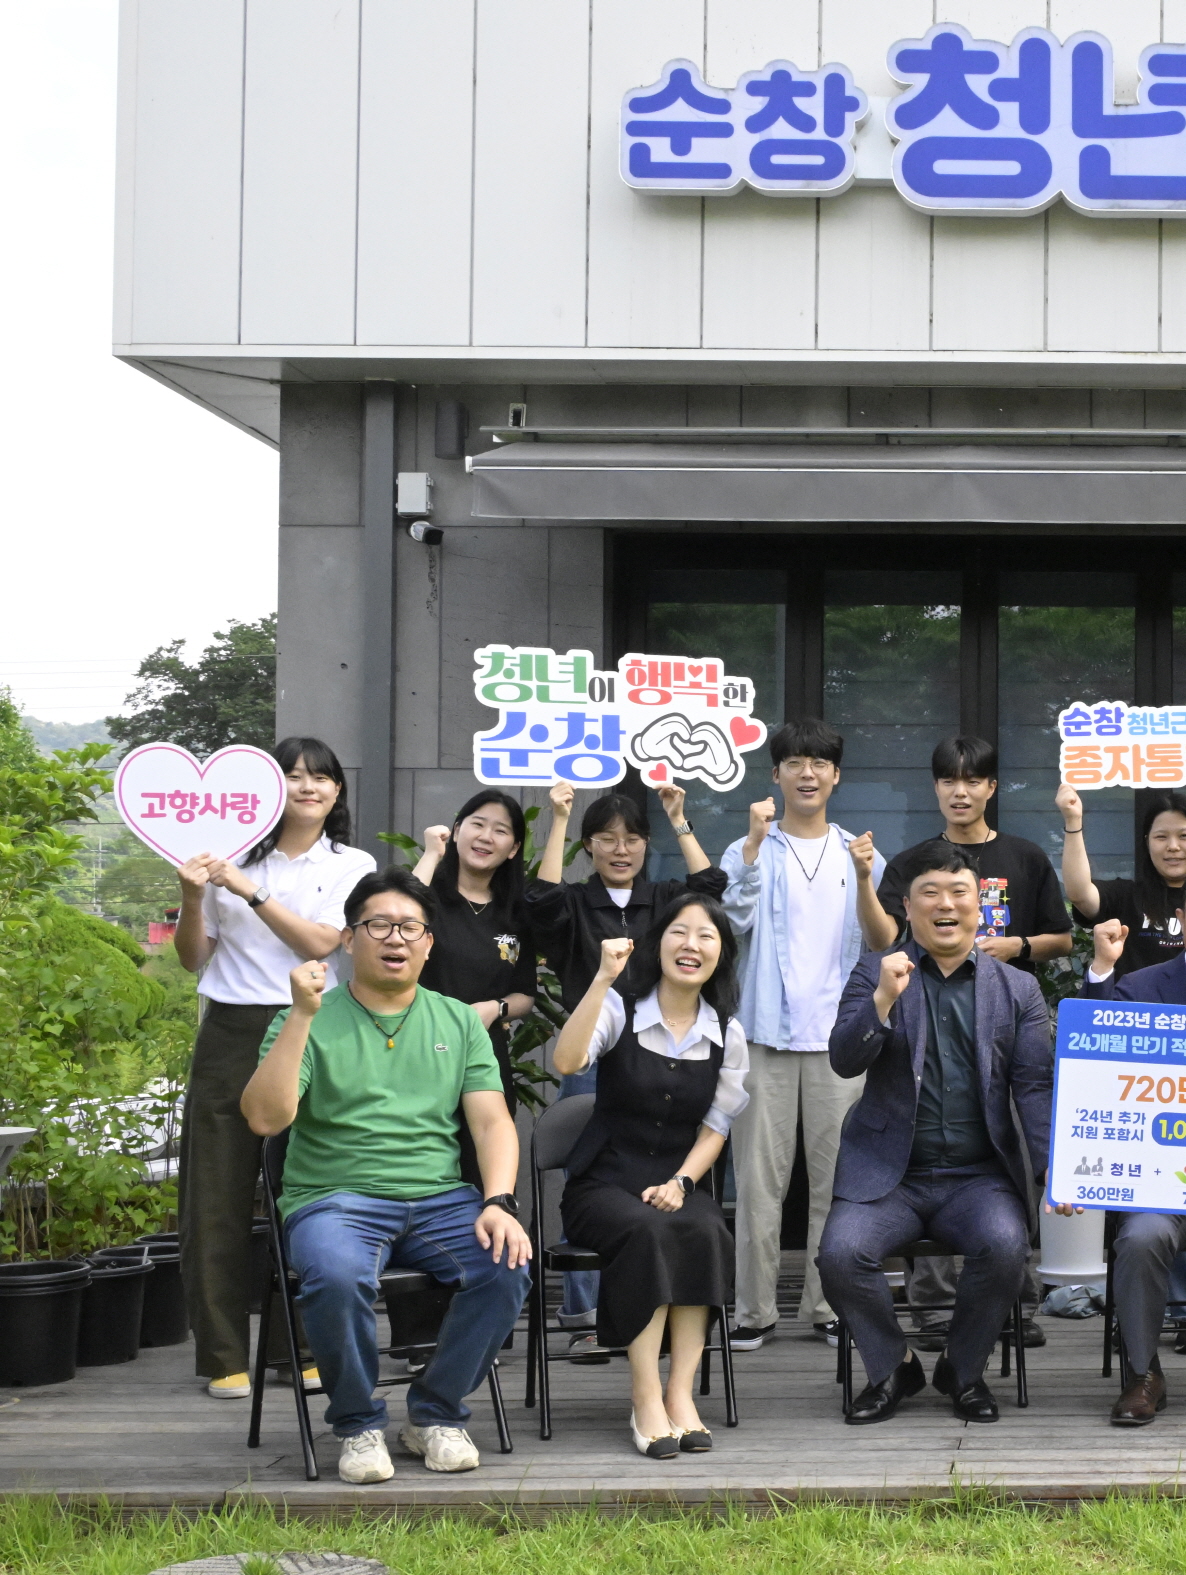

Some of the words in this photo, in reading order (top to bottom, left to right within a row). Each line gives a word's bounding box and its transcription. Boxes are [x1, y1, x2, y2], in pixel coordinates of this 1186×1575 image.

[626, 67, 861, 182] 순창
[479, 651, 615, 705] 청년이
[625, 658, 749, 708] 행복한
[1062, 706, 1125, 737] 순창
[480, 711, 627, 782] 순창
[140, 789, 261, 825] 고향사랑
[1092, 1009, 1151, 1029] 2023년
[1067, 1032, 1128, 1054] 24개월
[1131, 1035, 1168, 1056] 만기
[1117, 1110, 1146, 1126] 추가
[1071, 1125, 1099, 1140] 지원
[1102, 1126, 1144, 1142] 포함시
[1076, 1185, 1135, 1202] 360만원
